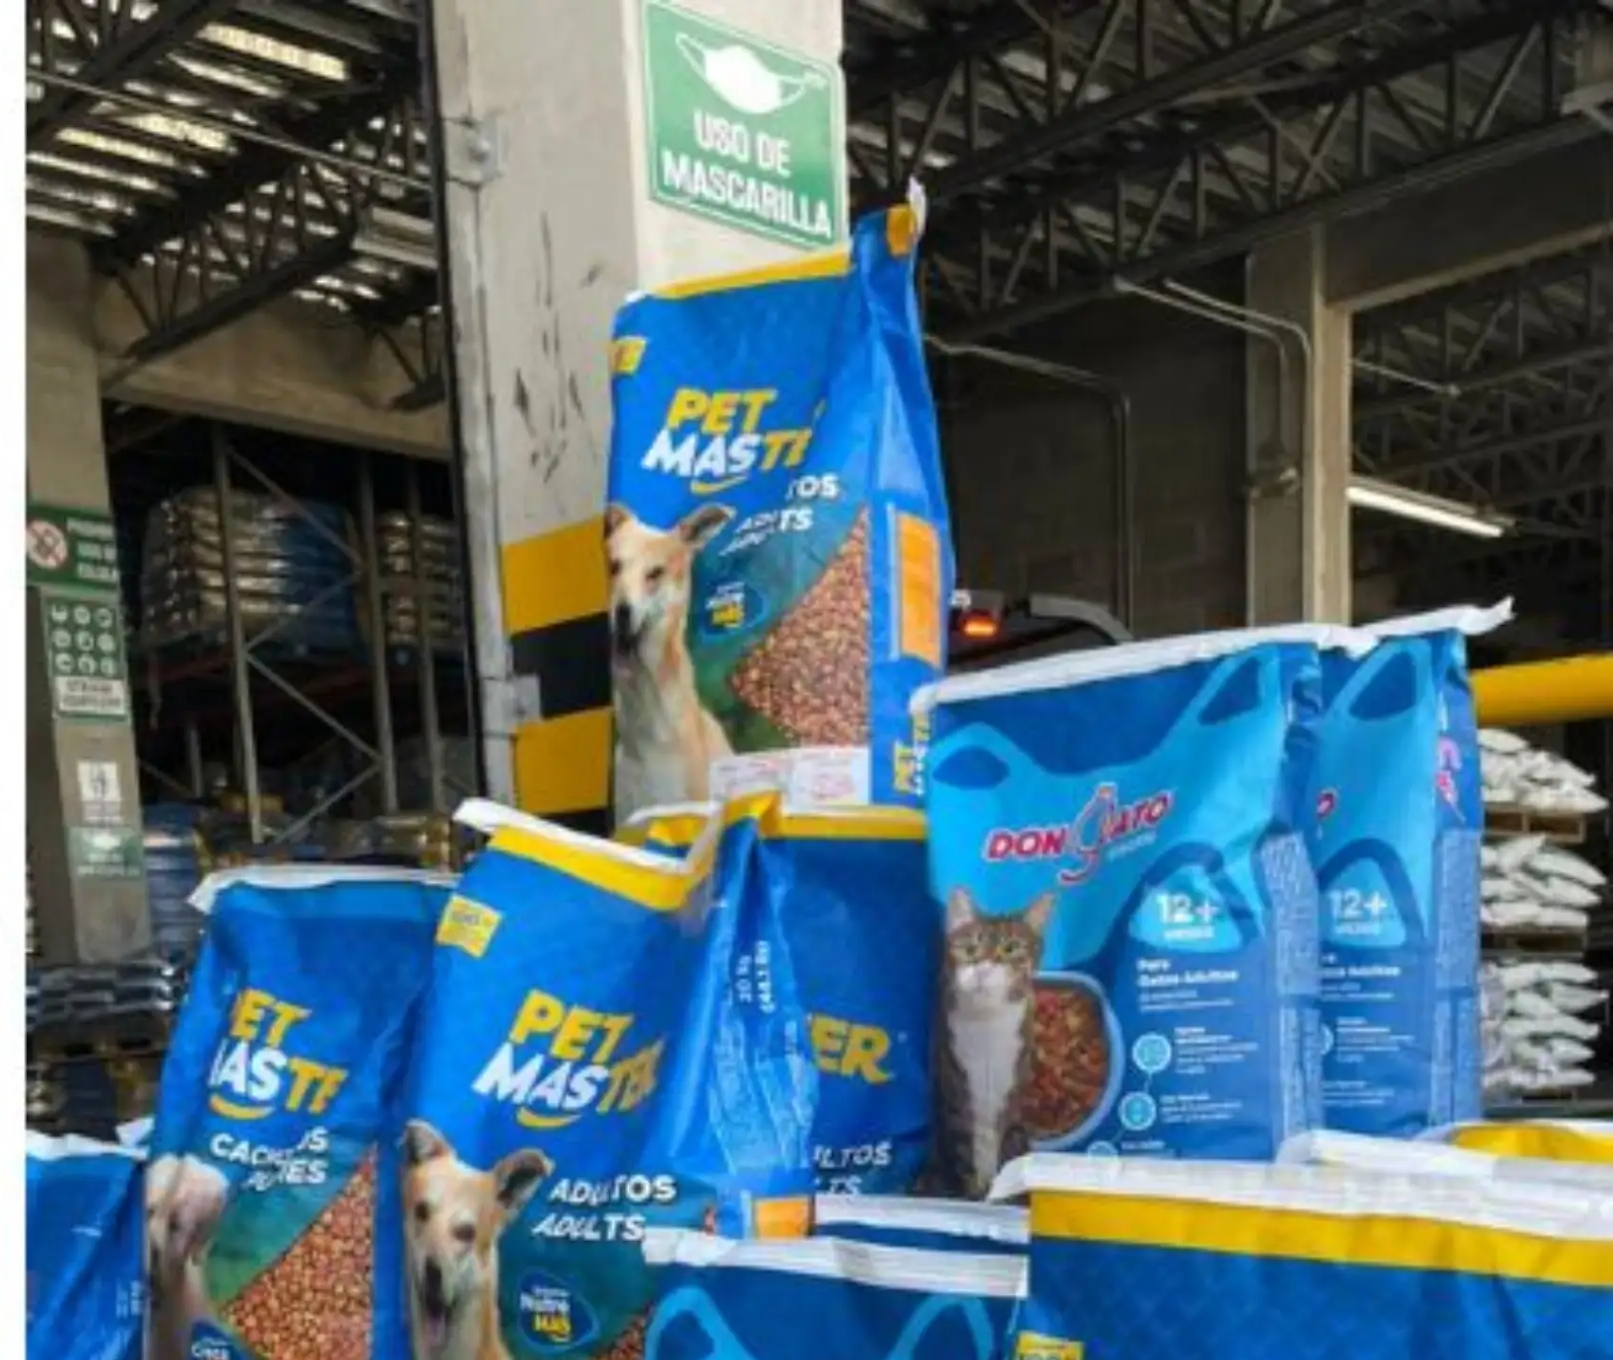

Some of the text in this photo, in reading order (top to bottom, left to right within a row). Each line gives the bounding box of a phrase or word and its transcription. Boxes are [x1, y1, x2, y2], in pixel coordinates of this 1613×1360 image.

[693, 107, 792, 179] USO DE
[661, 146, 832, 240] MASCARILLA
[667, 385, 778, 434] PET
[984, 825, 1068, 863] DON
[1156, 891, 1218, 924] 12+
[1328, 887, 1387, 918] 12+
[230, 987, 312, 1047] ET
[509, 987, 634, 1064] PET
